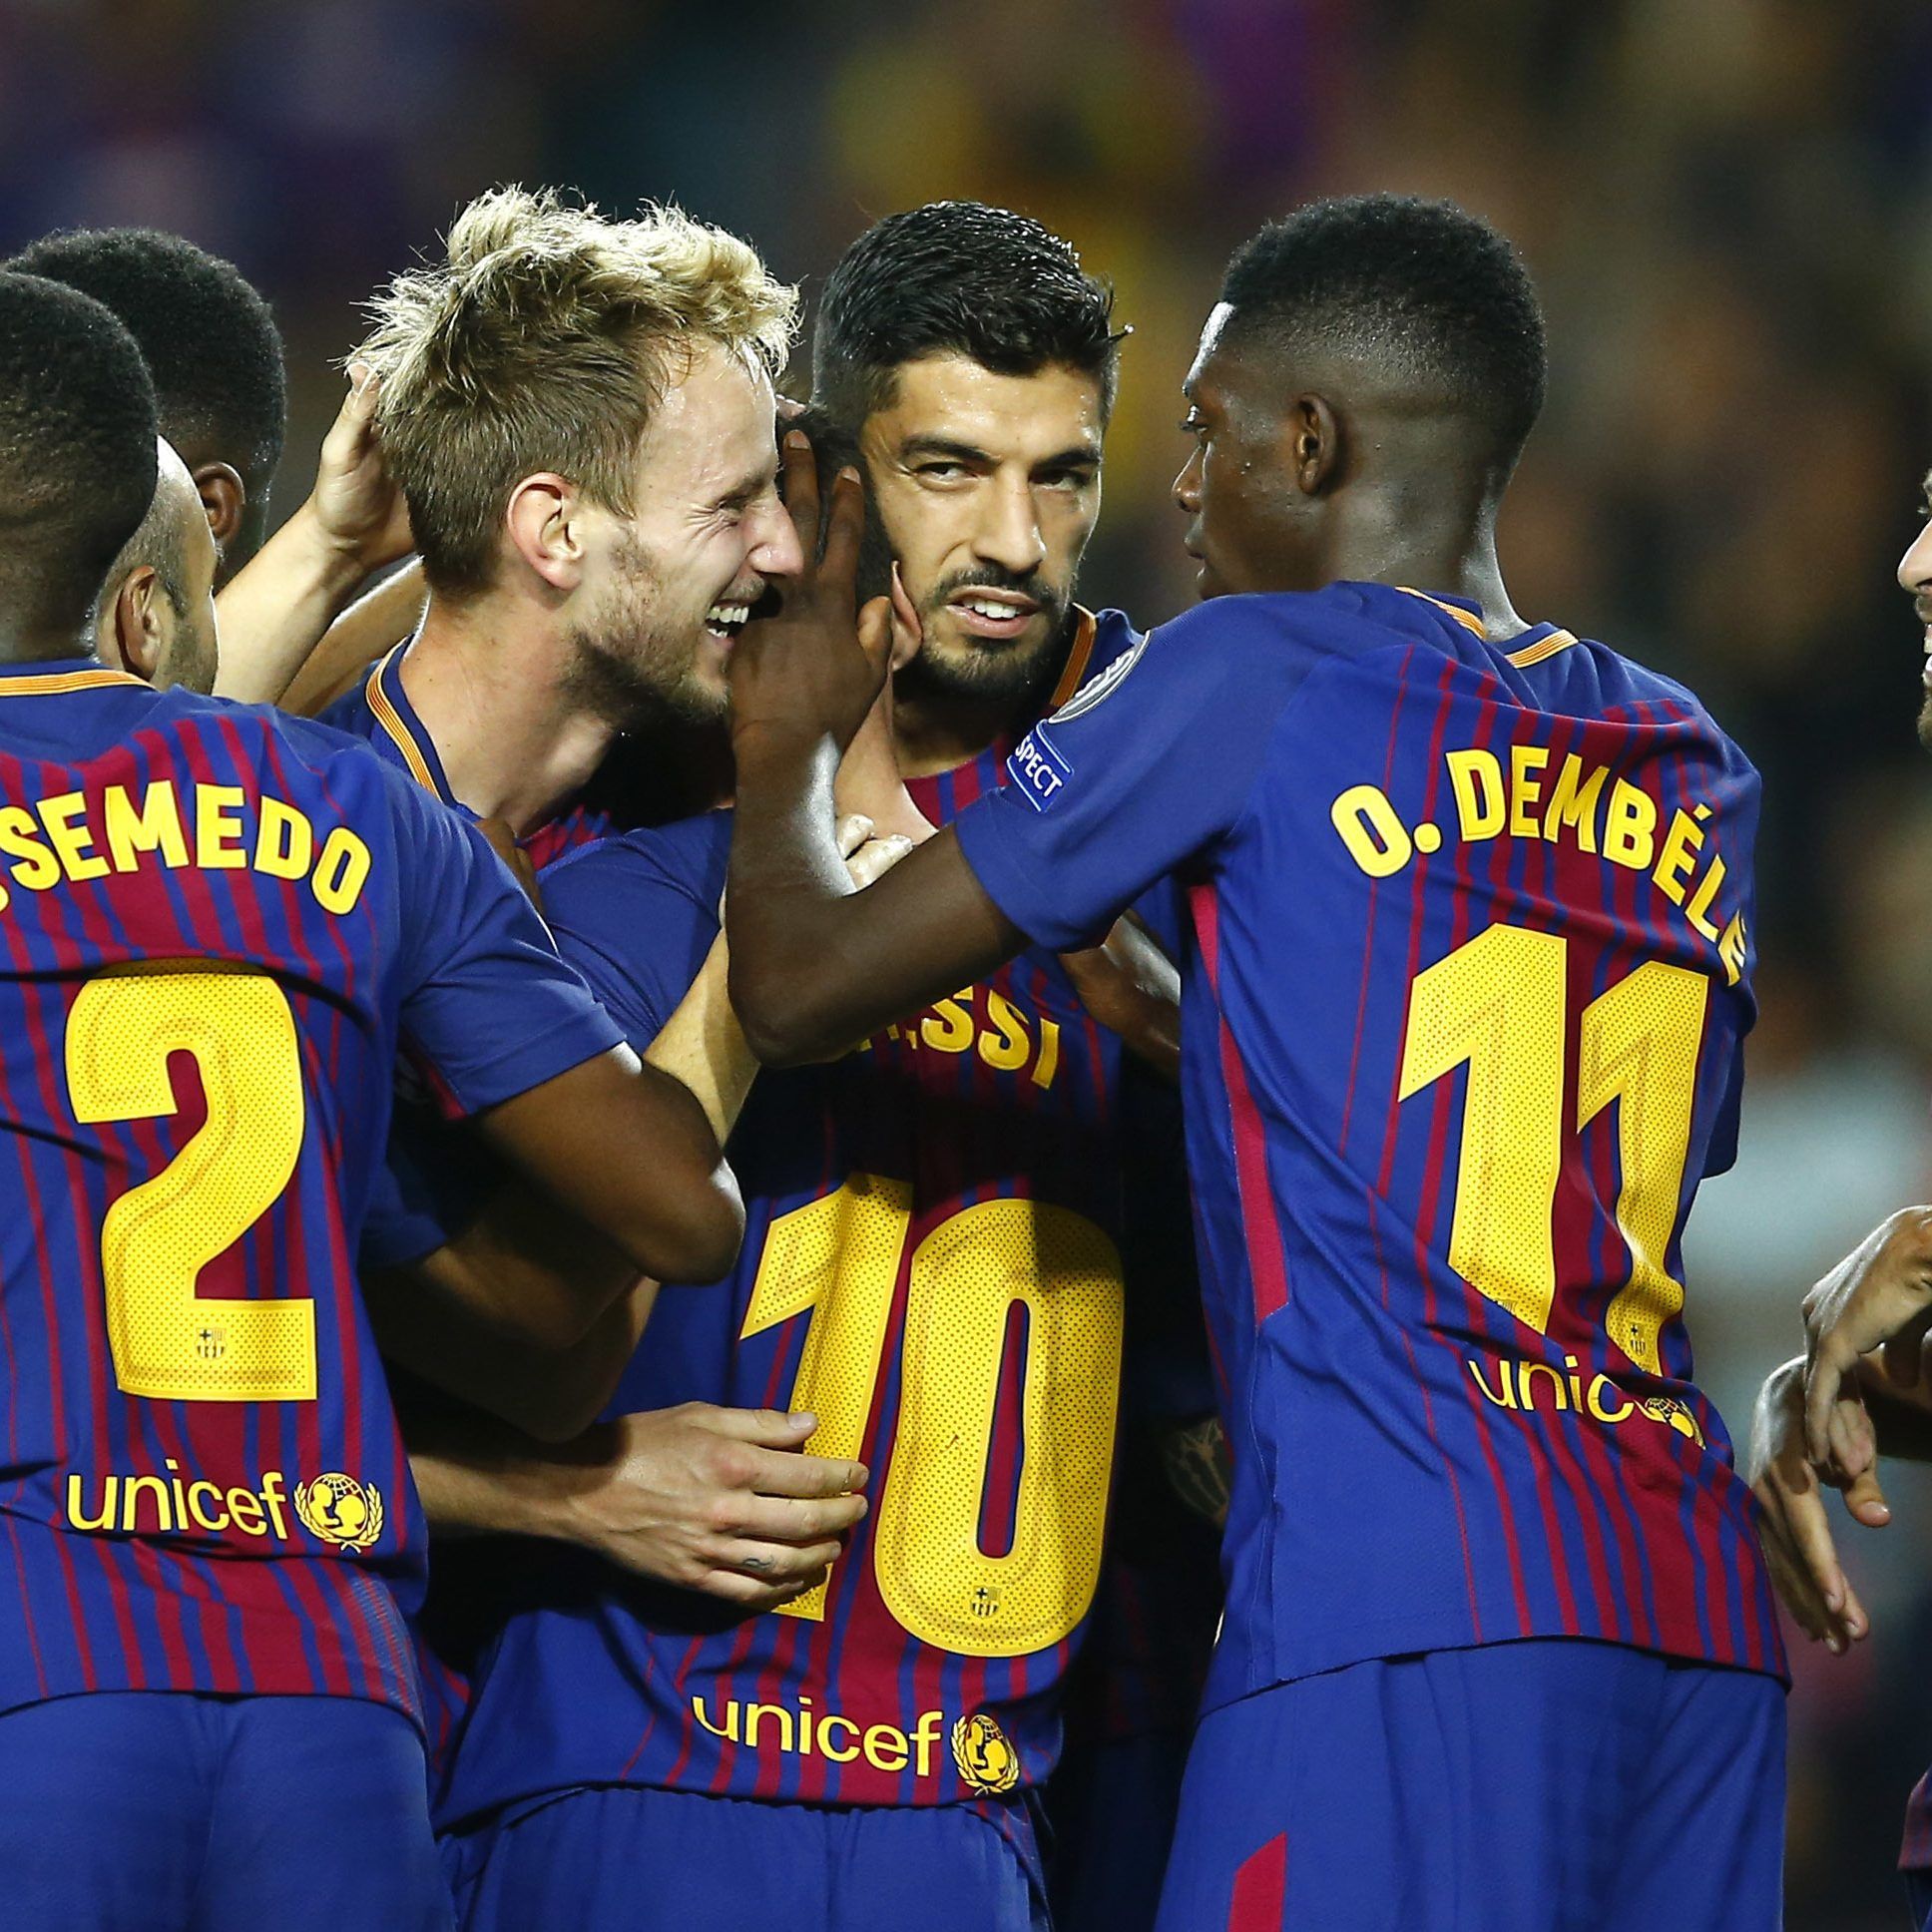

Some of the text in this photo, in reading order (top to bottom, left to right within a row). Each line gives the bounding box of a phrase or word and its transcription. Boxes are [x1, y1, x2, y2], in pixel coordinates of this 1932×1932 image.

[1330, 783, 1442, 879] O.
[859, 985, 1061, 1091] SSI
[64, 956, 317, 1401] 2
[1397, 921, 1709, 1377] 11
[739, 1173, 1125, 1658] 10
[66, 1458, 290, 1541] unicef
[691, 1695, 944, 1777] unicef
